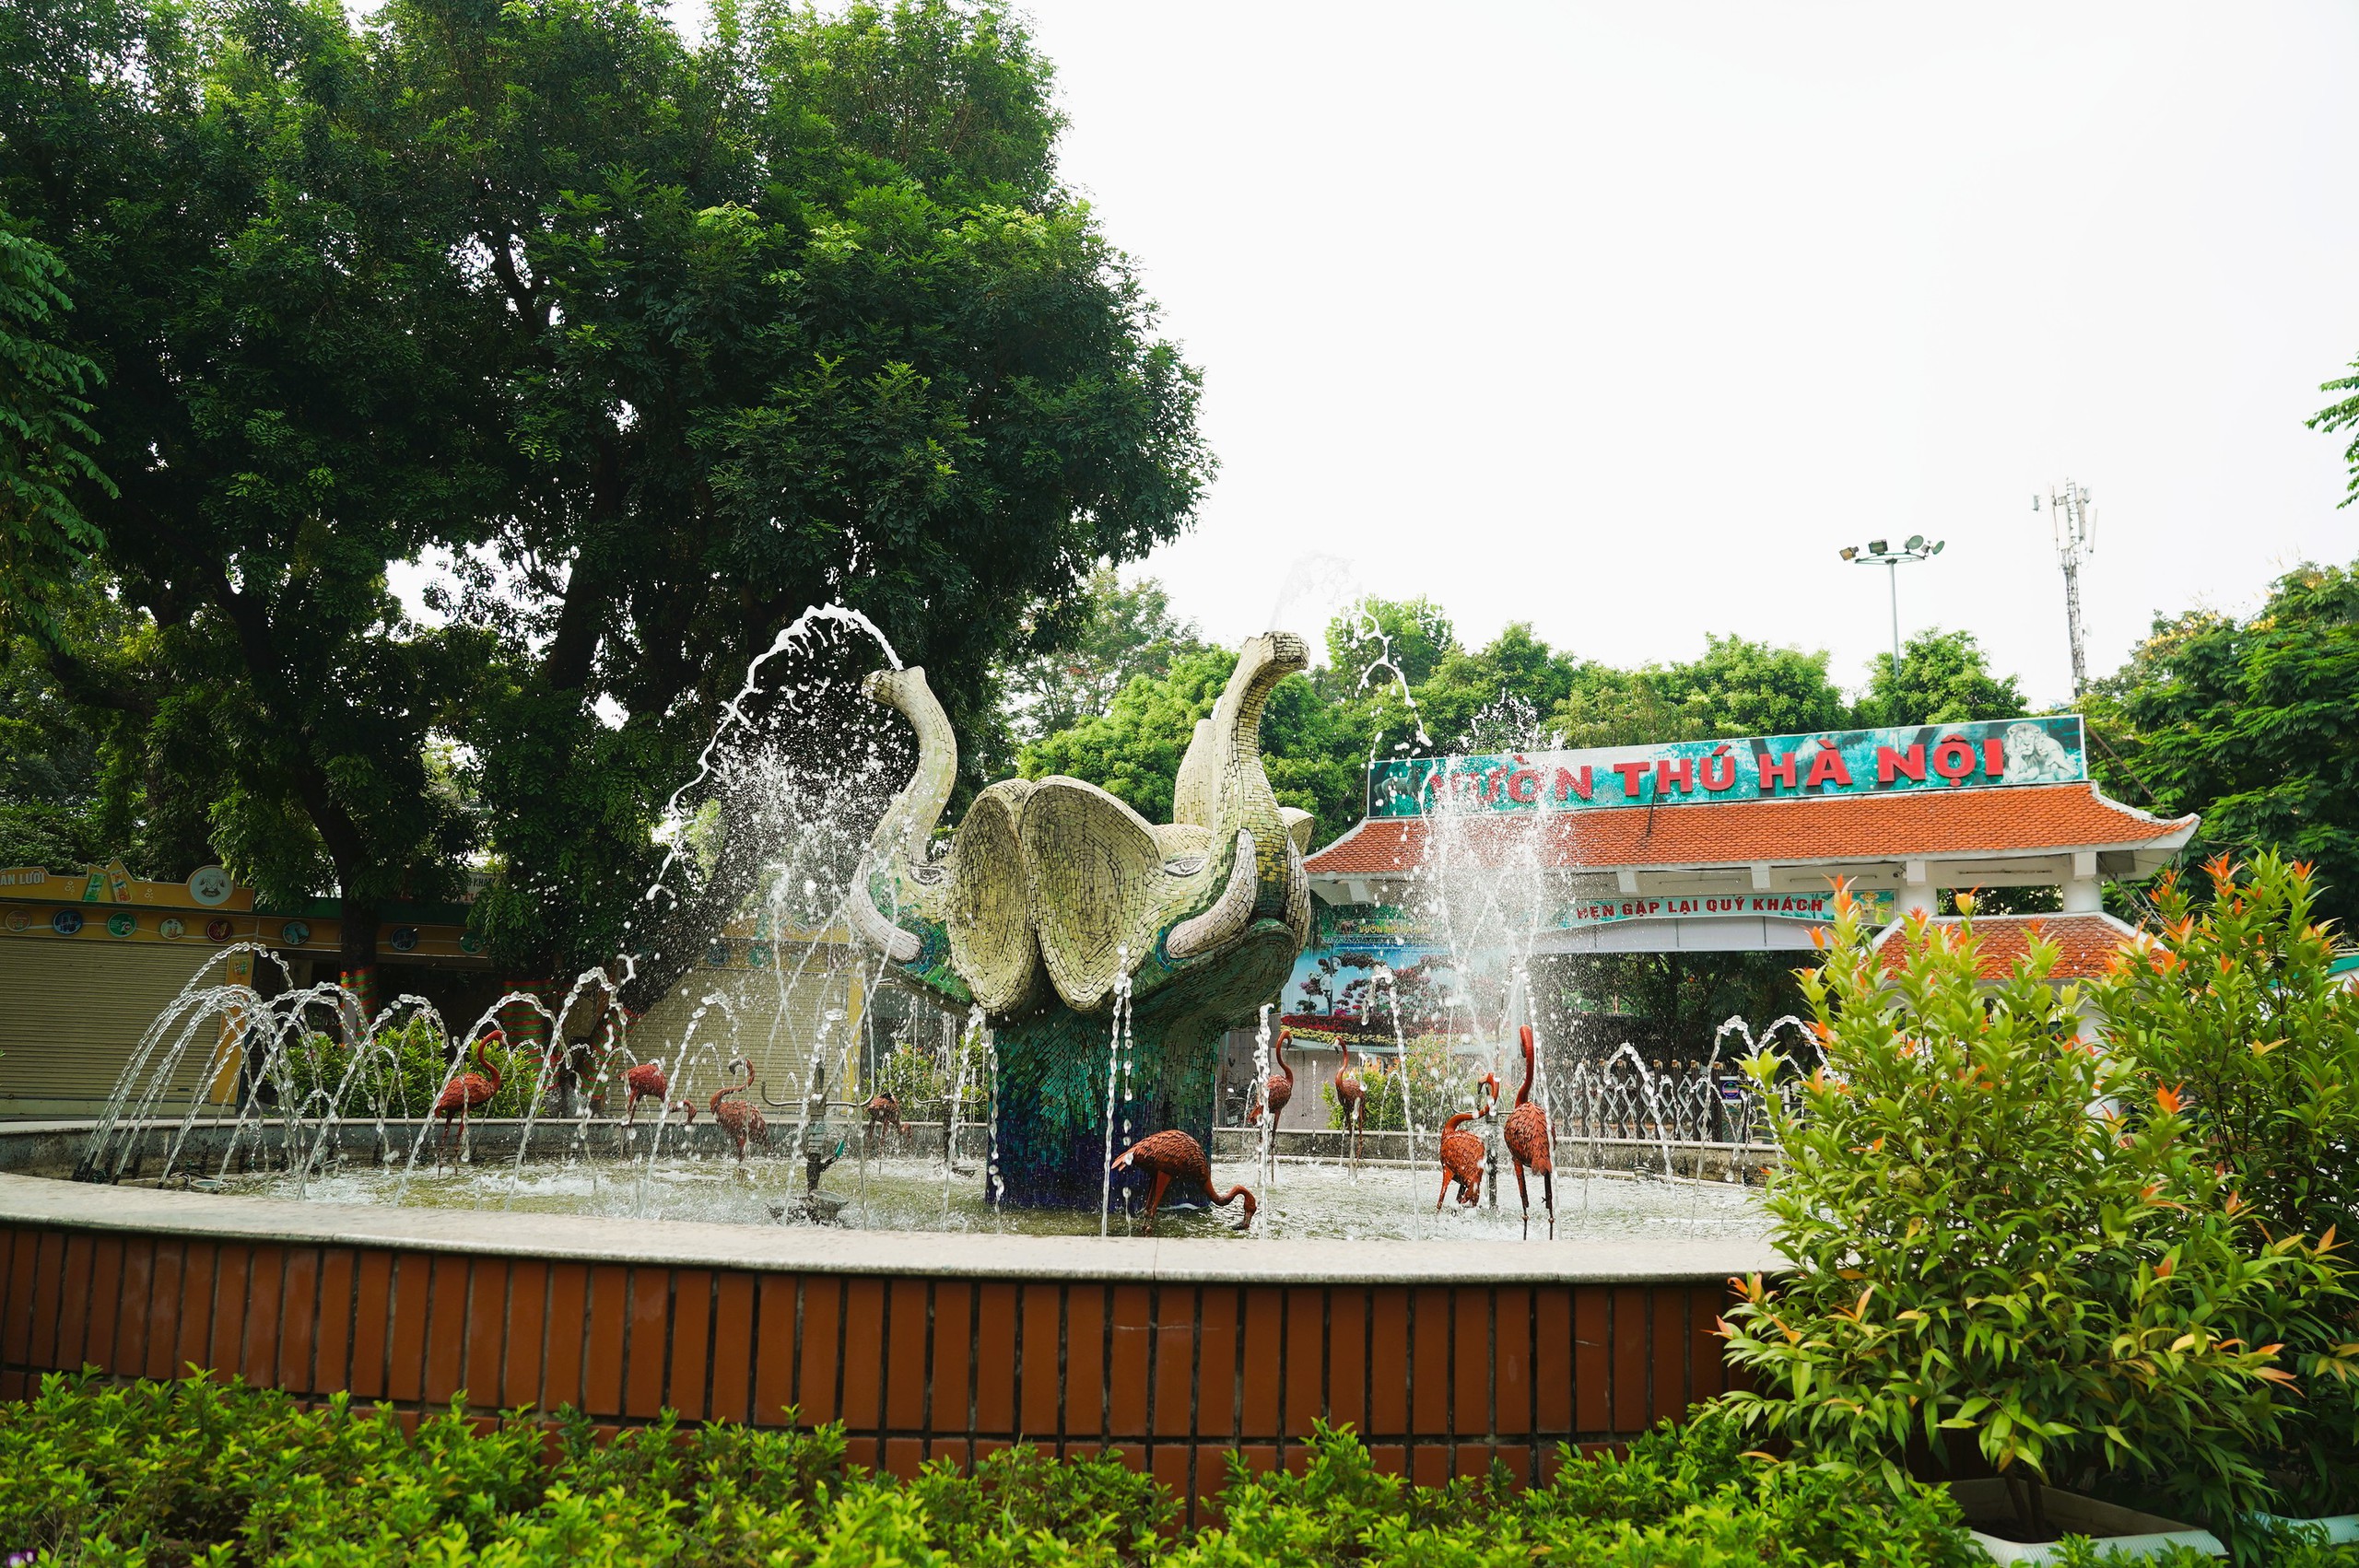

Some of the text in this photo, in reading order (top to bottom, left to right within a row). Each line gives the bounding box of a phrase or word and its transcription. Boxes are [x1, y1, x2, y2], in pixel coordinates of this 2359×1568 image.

[1613, 744, 1736, 796] THÚ
[1758, 740, 1854, 790] HÀ
[1876, 733, 2004, 787] NỘI
[1577, 896, 1823, 920] HẸN GẶP LẠI QUÝ KHÁCH
